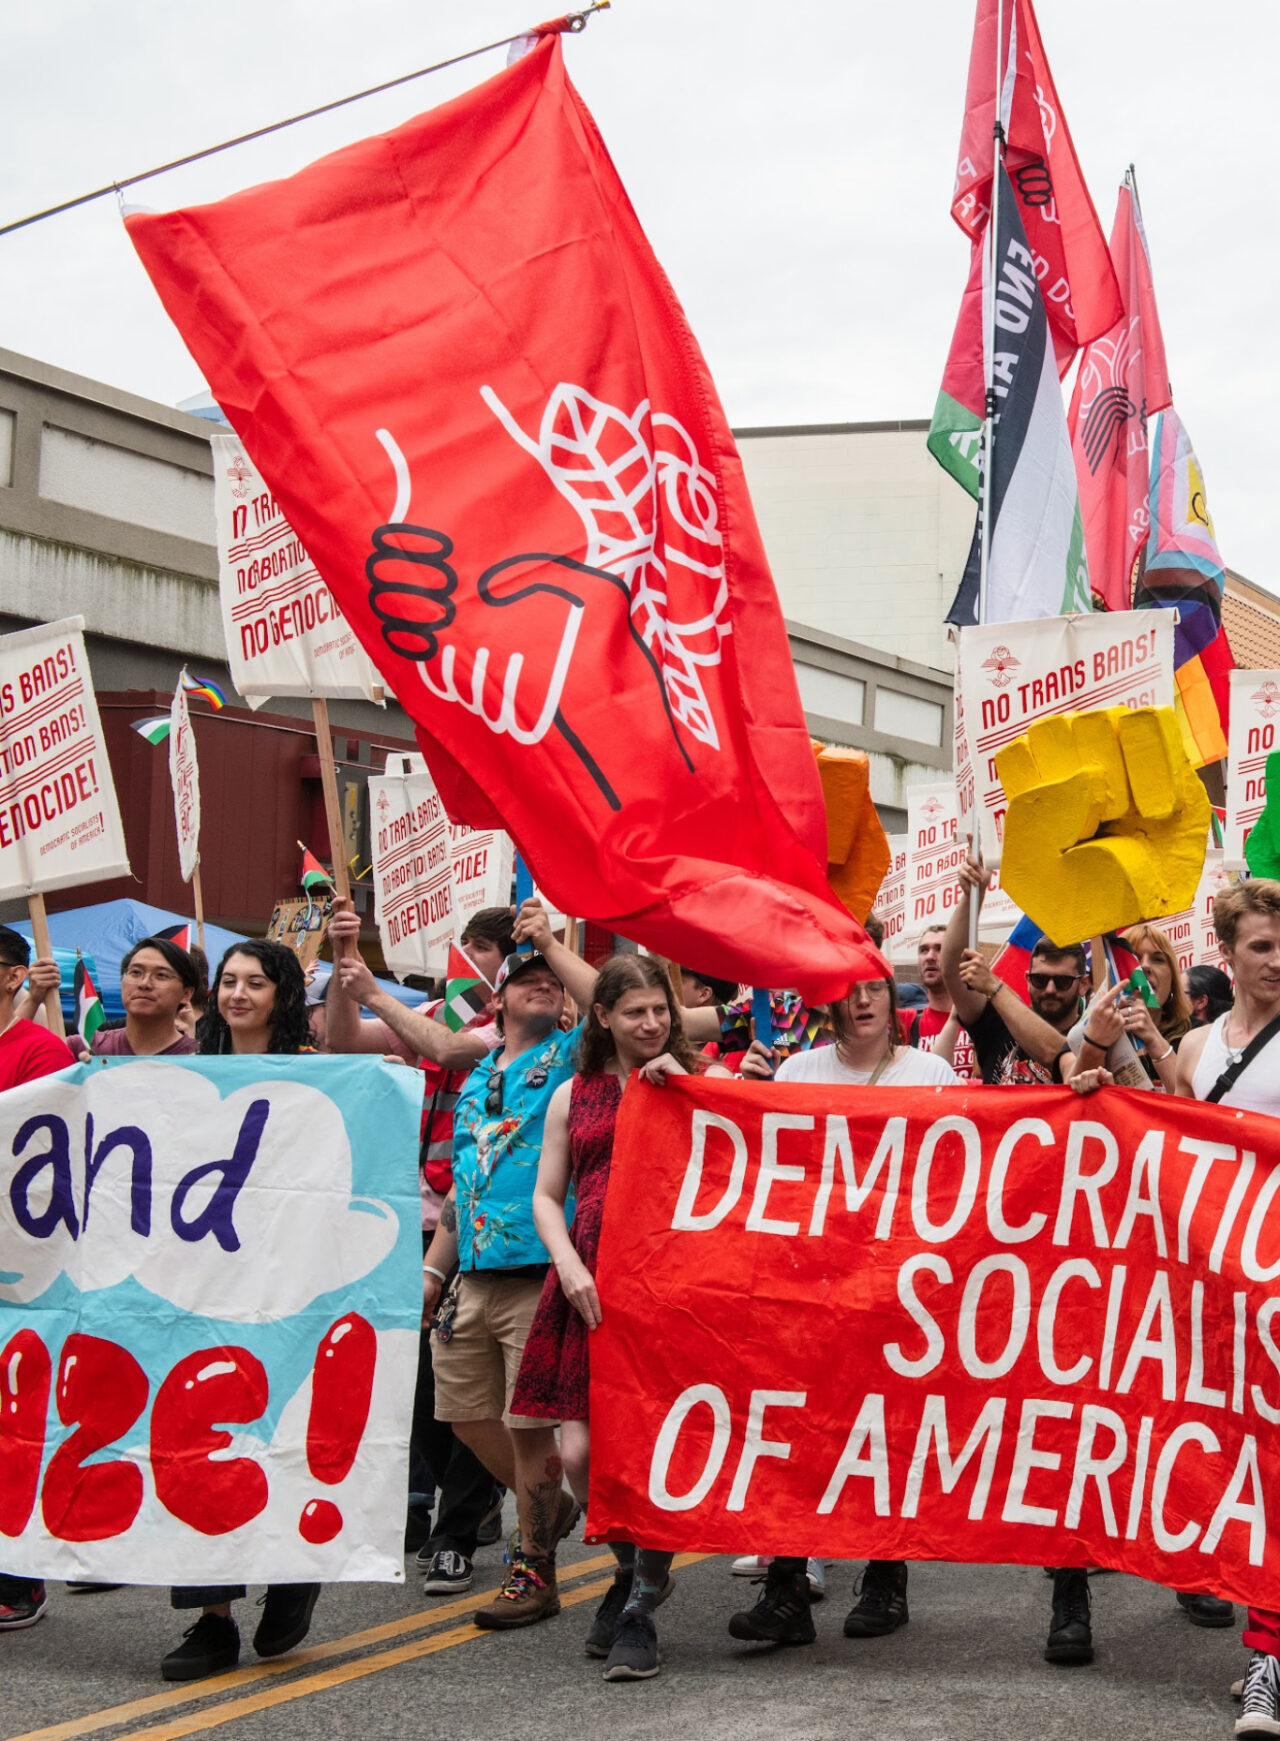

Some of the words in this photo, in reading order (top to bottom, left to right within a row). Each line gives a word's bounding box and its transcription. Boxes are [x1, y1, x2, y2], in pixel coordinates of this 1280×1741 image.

[240, 618, 269, 661] NO
[19, 643, 77, 704] BANS!
[981, 692, 1010, 730] NO
[1017, 660, 1086, 713] TRANS
[1093, 629, 1156, 682] BANS!
[39, 704, 87, 752] BANS!
[1248, 723, 1274, 754] NO
[40, 831, 70, 856] DEMOCRATIC
[70, 840, 77, 850] OF
[918, 826, 936, 848] NO
[941, 817, 957, 839] TR
[895, 852, 906, 872] BA
[916, 862, 932, 881] NO
[937, 847, 969, 873] ABOR
[914, 893, 936, 921] NO
[387, 915, 401, 948] NO
[1162, 922, 1191, 943] TION
[9, 1099, 270, 1253] and
[648, 1383, 808, 1514] OF
[817, 1392, 1267, 1567] AMERICA
